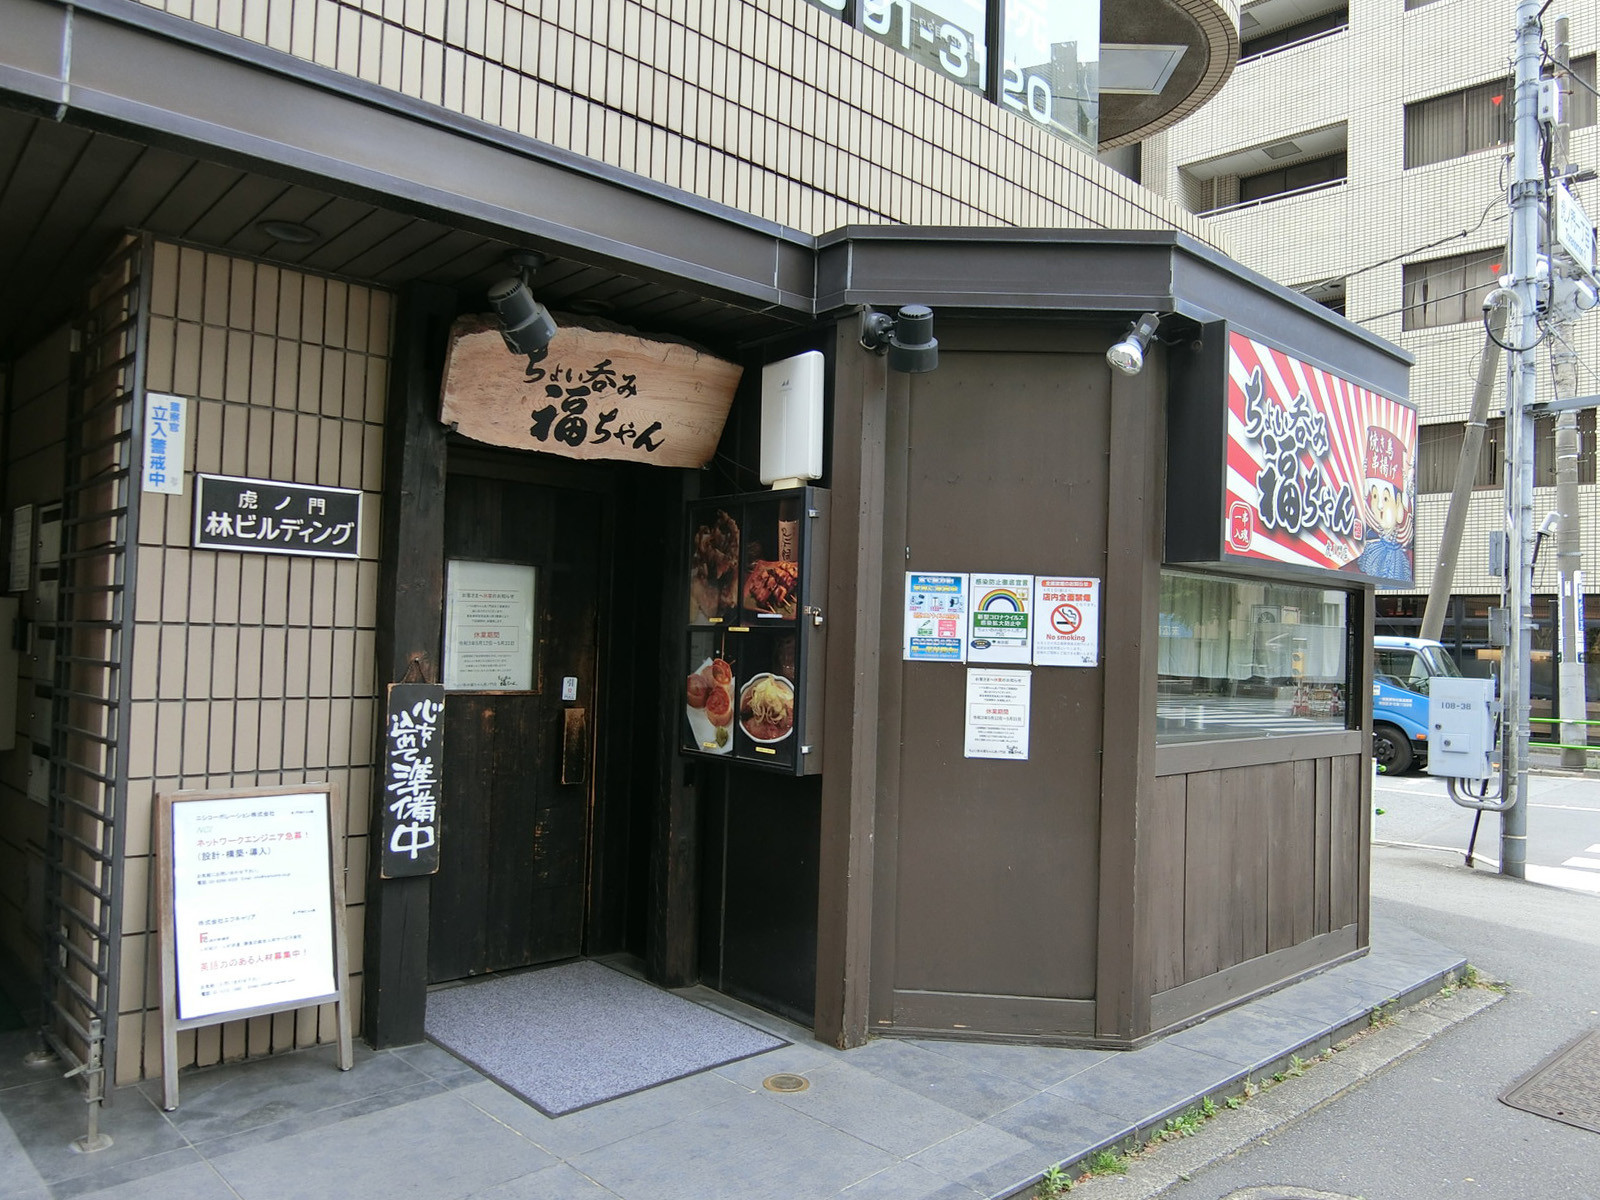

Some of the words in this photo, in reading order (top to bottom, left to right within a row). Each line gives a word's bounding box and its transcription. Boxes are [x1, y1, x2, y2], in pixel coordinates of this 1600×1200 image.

[169, 402, 181, 432] 警察官
[531, 384, 665, 453] 福ちゃん
[1245, 366, 1329, 457] ちょい呑み
[149, 406, 168, 487] 立入警戒中
[1370, 431, 1394, 461] 焼き鳥
[238, 490, 326, 516] 虎ノ門
[1257, 434, 1356, 535] 福ちゃん
[205, 510, 355, 547] 林ビルディング
[1057, 634, 1086, 642] smoking
[413, 699, 444, 748] 心を
[1441, 702, 1472, 710] 108-38
[388, 757, 437, 859] 準備中
